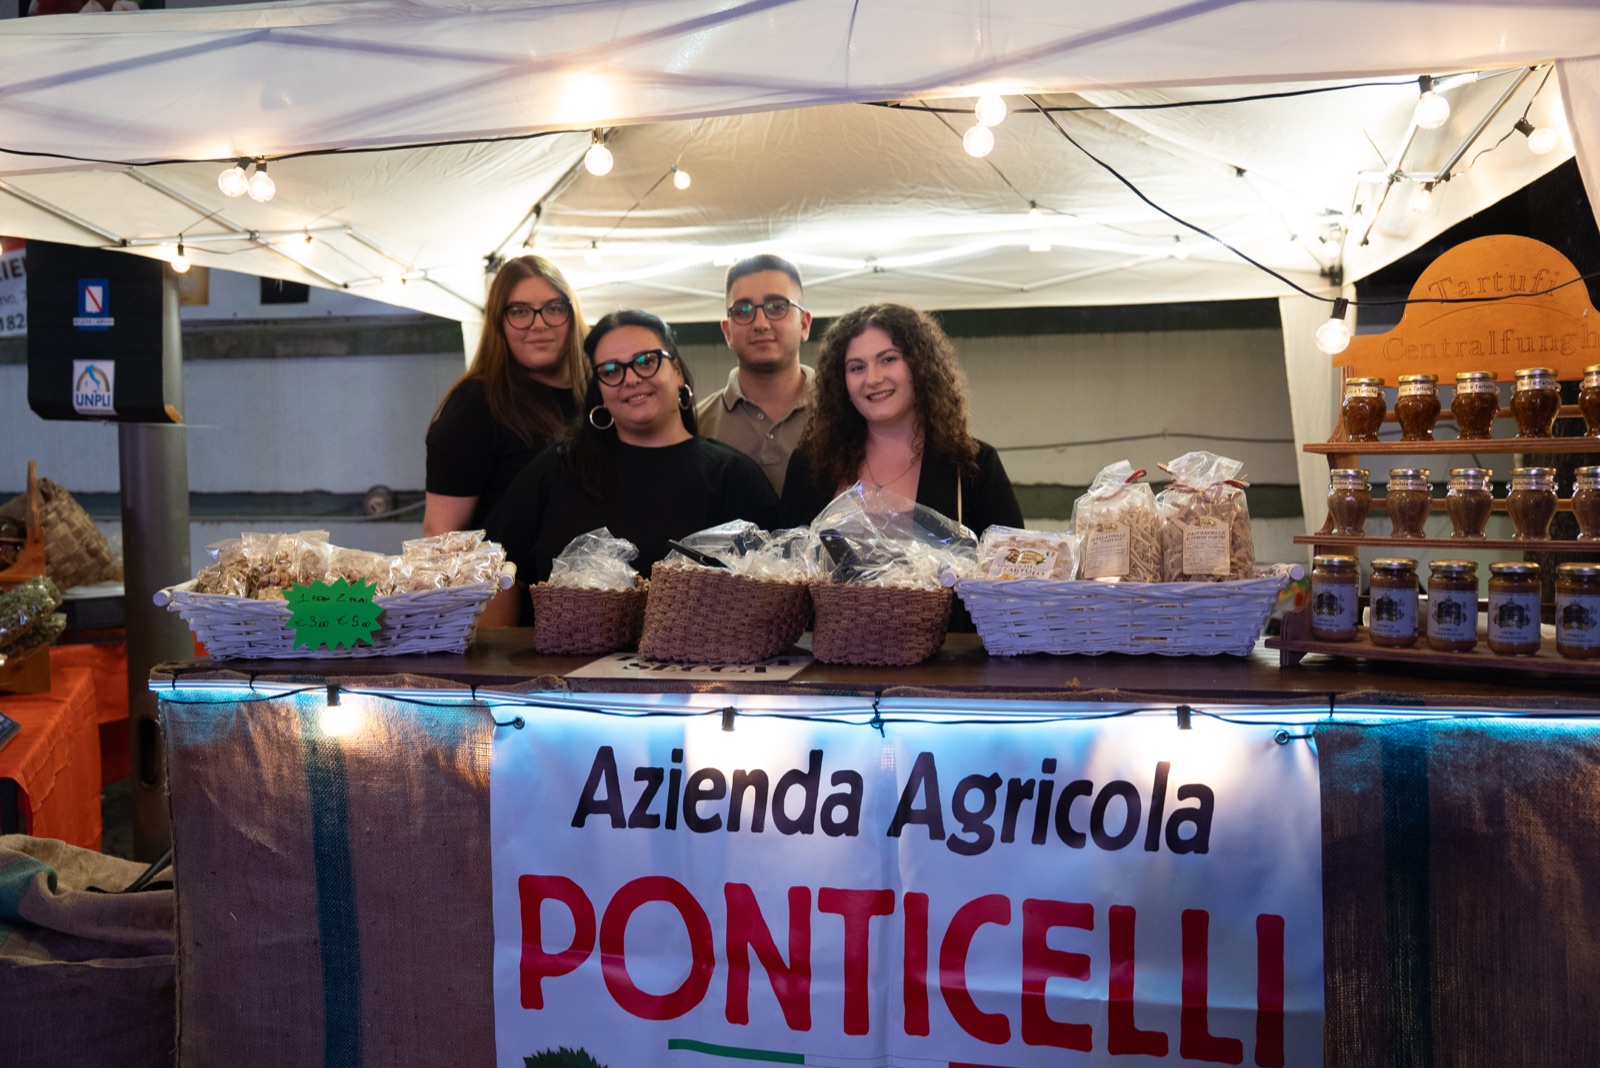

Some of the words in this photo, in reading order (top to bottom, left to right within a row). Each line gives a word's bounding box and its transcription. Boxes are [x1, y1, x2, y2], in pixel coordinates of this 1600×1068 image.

[1428, 269, 1560, 303] Tartufi
[75, 393, 111, 407] UNPLI
[297, 593, 309, 603] 1
[336, 593, 346, 602] 2
[571, 745, 863, 837] Azienda
[886, 751, 1214, 856] Agricola
[518, 873, 1285, 1067] PONTICELLI
